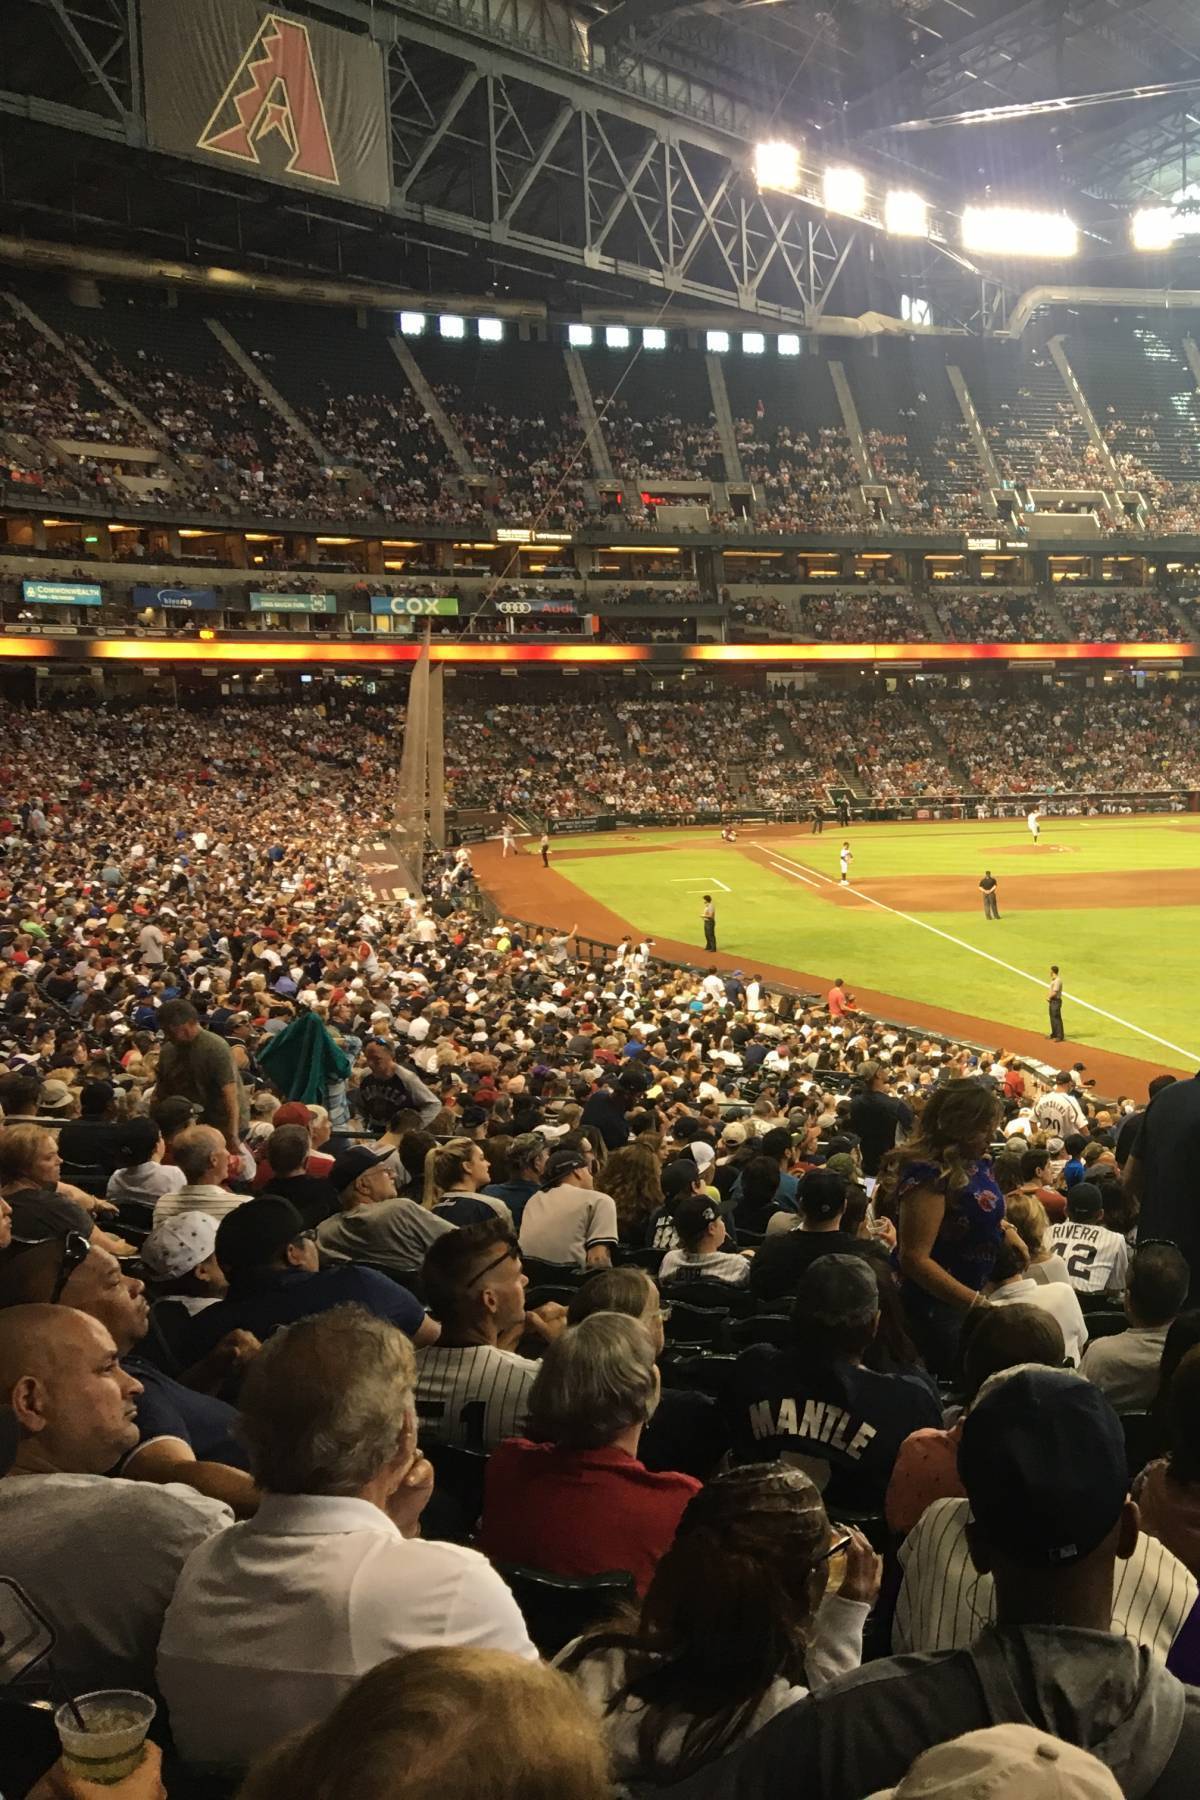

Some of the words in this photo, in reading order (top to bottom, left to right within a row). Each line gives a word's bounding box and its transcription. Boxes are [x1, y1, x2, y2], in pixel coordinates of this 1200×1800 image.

[391, 597, 440, 614] COX
[542, 603, 575, 614] Audi
[1052, 1224, 1100, 1244] RIVERA
[749, 1398, 878, 1461] MANTLE
